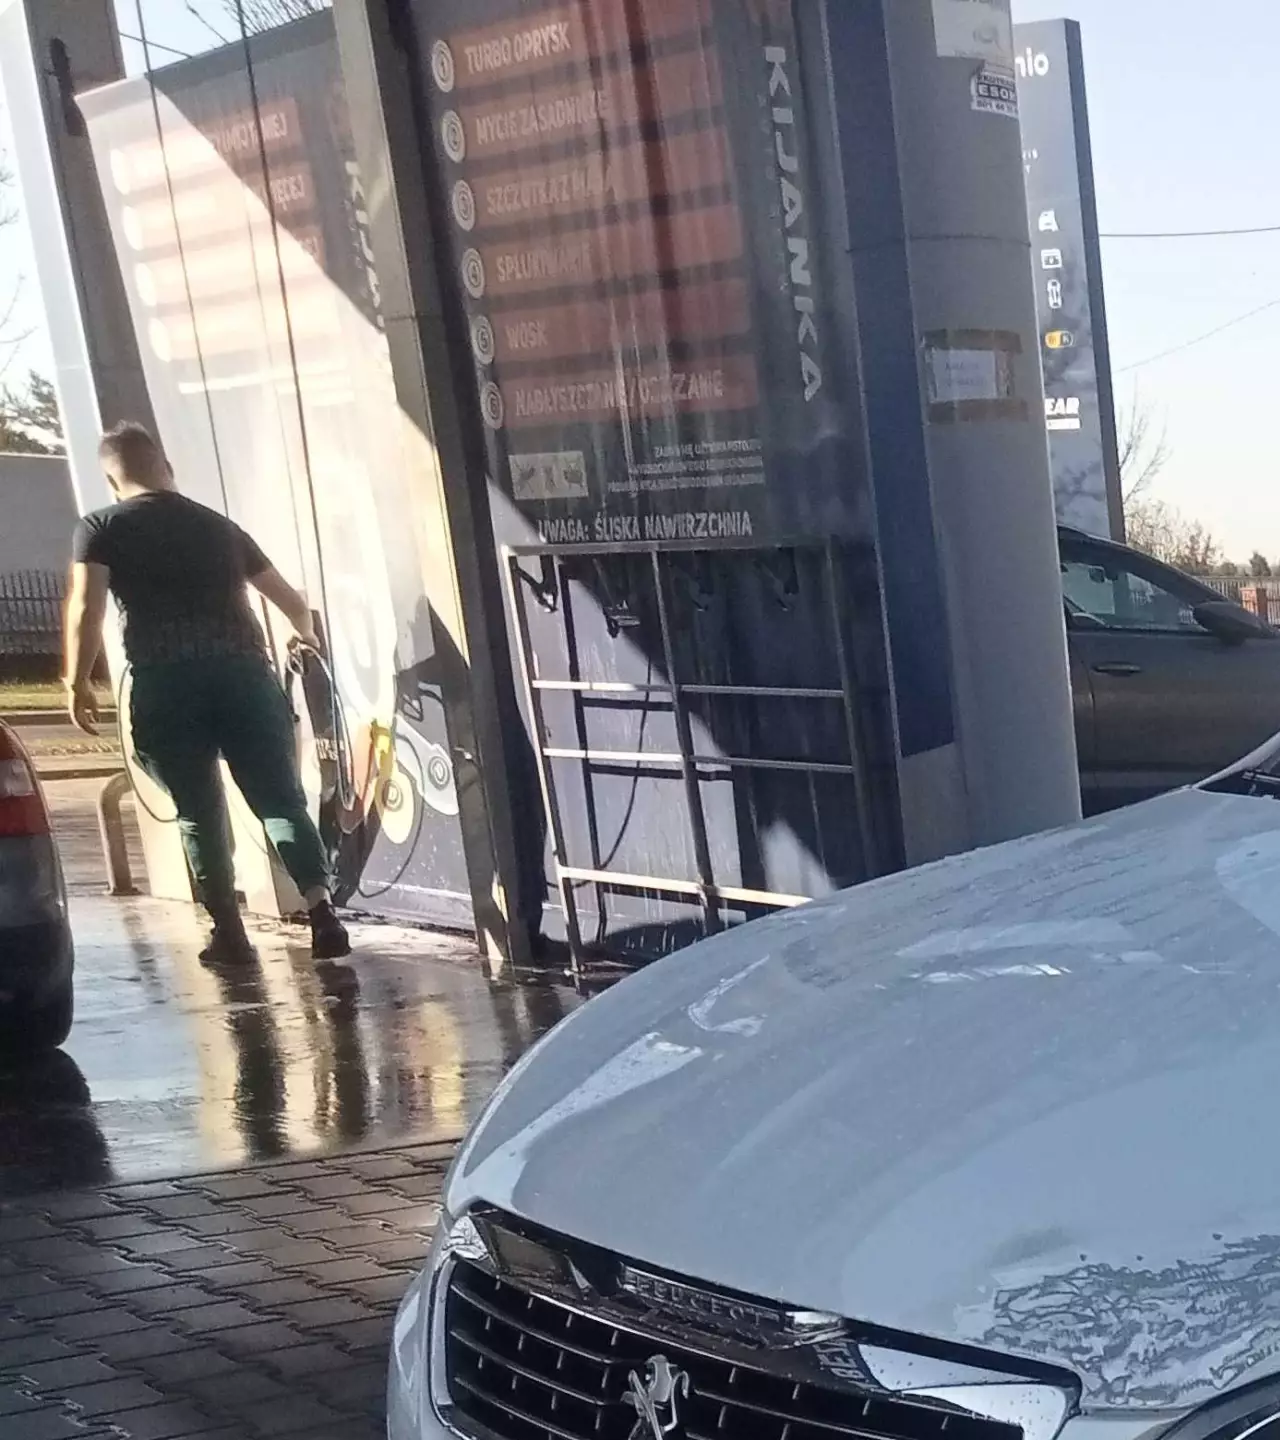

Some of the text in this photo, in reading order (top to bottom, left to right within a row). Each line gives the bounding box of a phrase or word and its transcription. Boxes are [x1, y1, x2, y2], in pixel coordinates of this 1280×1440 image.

[464, 21, 572, 75] TURBO OPRYSK
[764, 46, 823, 402] KIJANKA
[506, 319, 549, 349] WOSK
[595, 509, 641, 541] ŚLISKA
[645, 510, 753, 540] NAWIERZCHNIA
